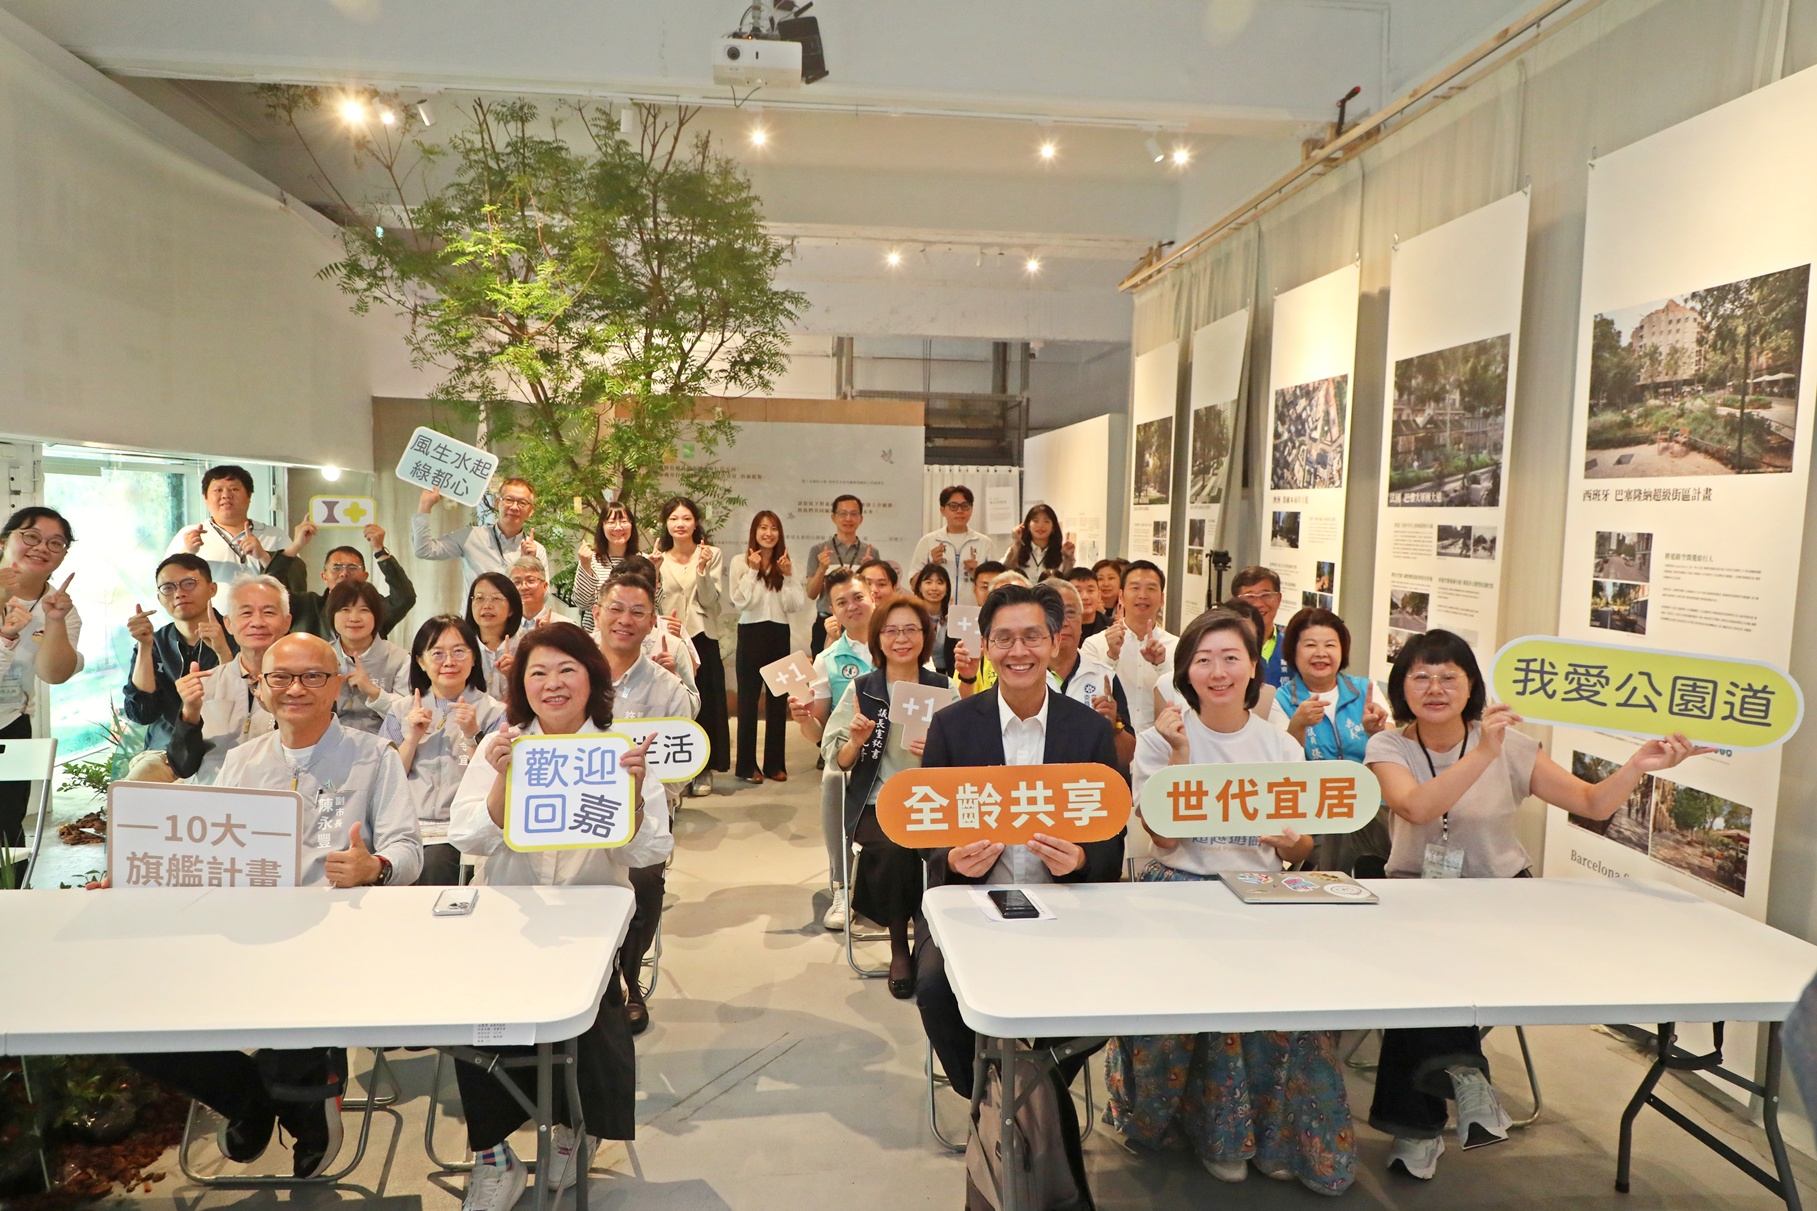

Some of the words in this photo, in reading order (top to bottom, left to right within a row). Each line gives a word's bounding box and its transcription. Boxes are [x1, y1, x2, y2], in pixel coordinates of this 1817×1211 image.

[410, 434, 492, 480] 風生水起
[410, 460, 469, 497] 綠都心
[1583, 488, 1610, 502] 西班牙
[775, 662, 807, 685] +1
[902, 697, 935, 723] +1
[1512, 657, 1776, 728] 我愛公園道
[524, 746, 617, 788] 歡迎
[334, 796, 345, 828] 副市長
[524, 792, 623, 839] 回嘉
[903, 778, 1108, 832] 全齡共享
[1166, 776, 1358, 823] 世代宜居
[164, 813, 247, 848] 10大
[317, 797, 334, 849] 陳永豐
[126, 851, 282, 887] 旗艦計畫
[1570, 848, 1620, 878] Barcelona
